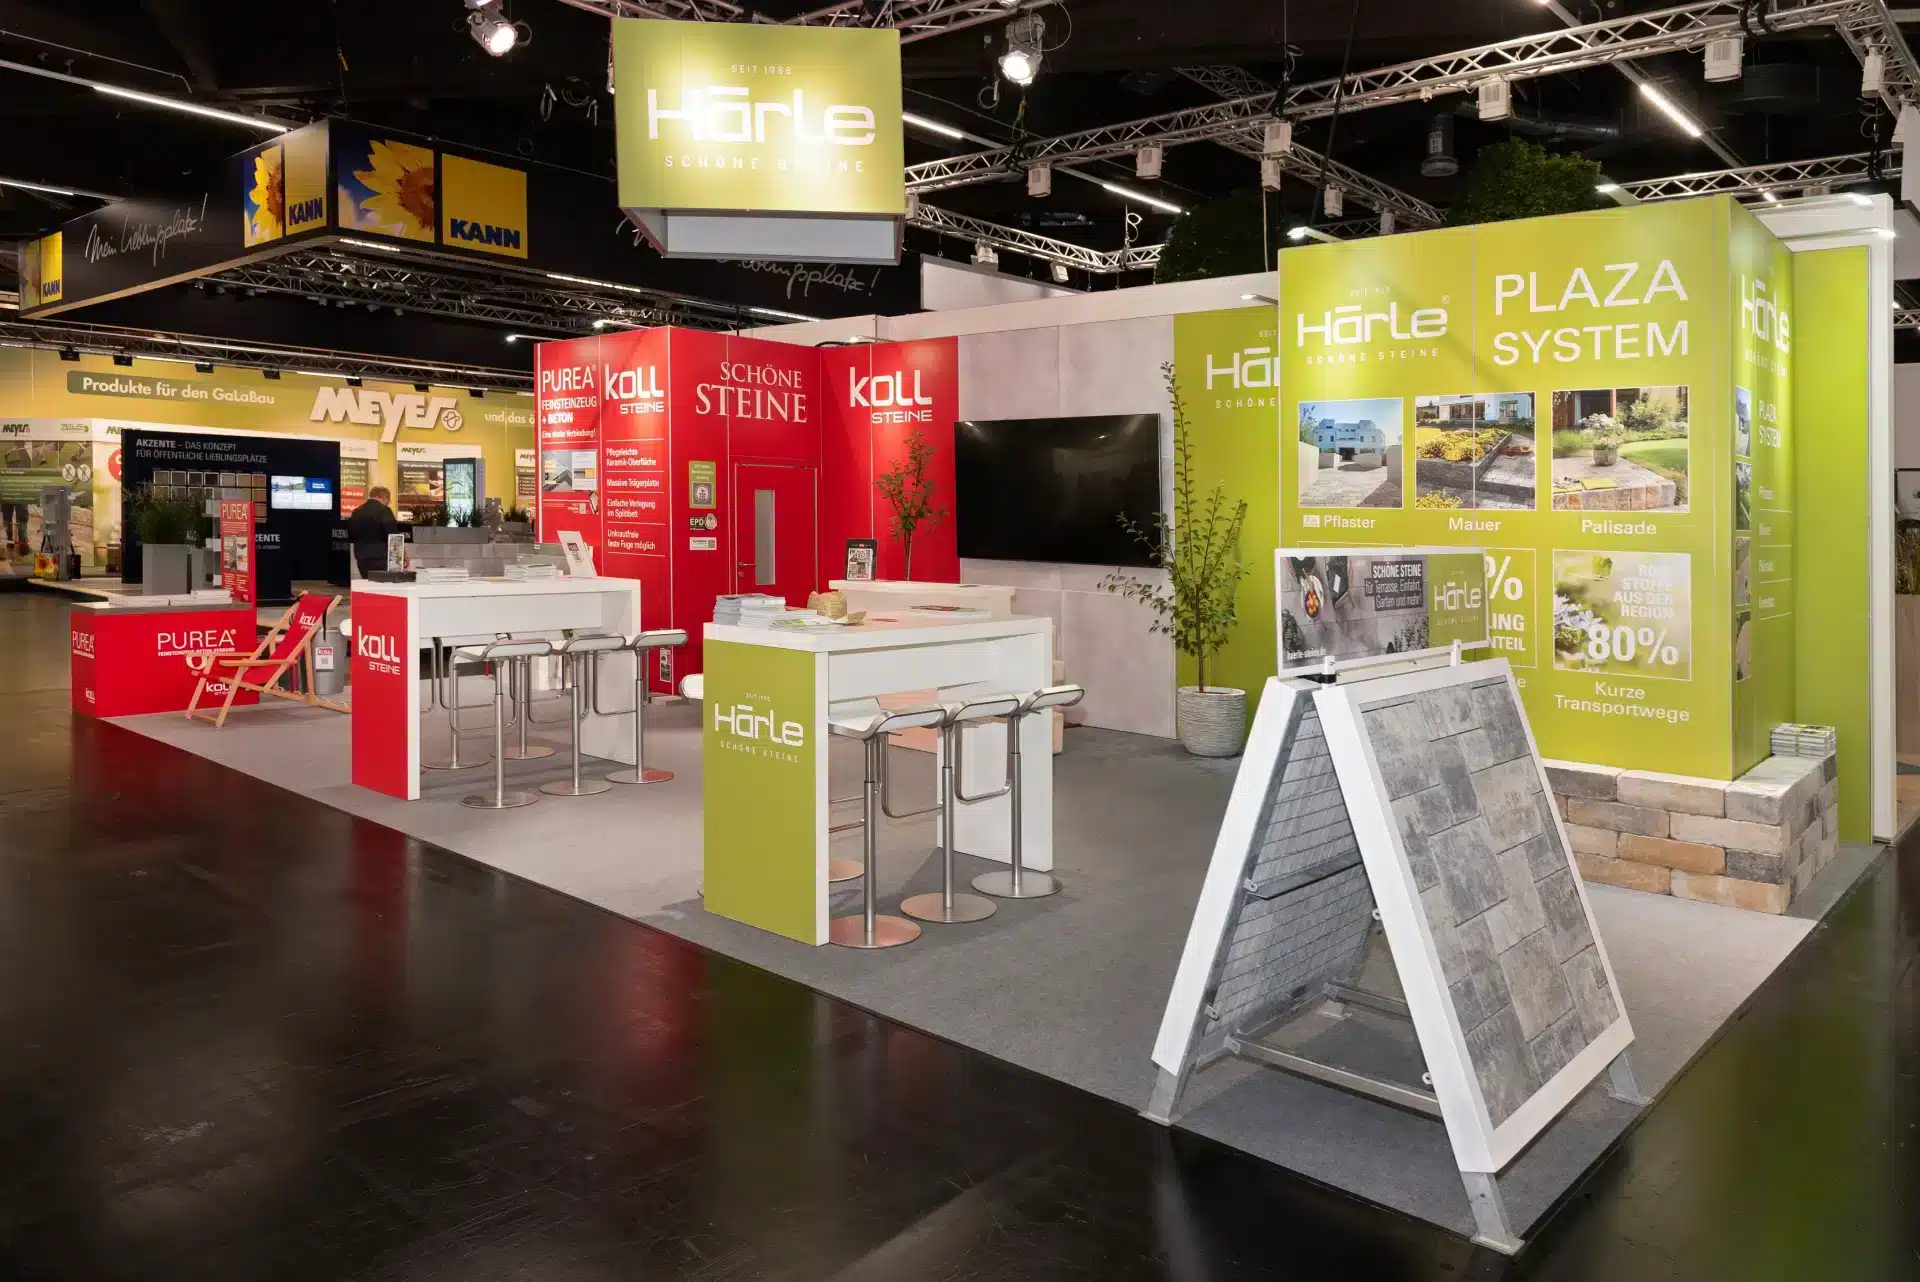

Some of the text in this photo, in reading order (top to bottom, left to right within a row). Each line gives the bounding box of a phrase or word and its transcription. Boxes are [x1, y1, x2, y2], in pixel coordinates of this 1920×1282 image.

[731, 64, 757, 74] SEIT
[289, 197, 323, 226] KANN
[450, 217, 520, 250] KANN
[42, 278, 61, 298] KANN
[1494, 259, 1689, 316] PLAZA
[1492, 320, 1689, 367] SYSTEM
[1379, 347, 1438, 361] STEINE
[720, 361, 802, 389] SCHÖNE
[82, 376, 275, 406] Produkte für den GaLaBau
[542, 395, 597, 411] FEINSTEINZEUG
[620, 401, 664, 415] STEINE
[695, 383, 808, 424] STEINE
[485, 411, 505, 422] und
[508, 412, 527, 424] das
[872, 409, 933, 424] STEINE
[136, 439, 176, 449] AKZENTE
[185, 441, 202, 450] DAS
[203, 442, 237, 452] KONZEPT
[136, 448, 268, 464] FÜR ÖFFENTLICHE LIEBLINGSPLÄTZE
[689, 517, 704, 527] EPD
[1323, 514, 1377, 529] Pflaster
[1448, 516, 1502, 531] Mauer
[1581, 519, 1657, 536] Palisade
[634, 541, 656, 552] möglich
[1372, 561, 1422, 579] SCHÖNE STEINE
[1612, 591, 1643, 605] AUS
[1621, 604, 1675, 619] REGION
[1587, 623, 1680, 667] 80%
[368, 660, 401, 676] STEINE
[1595, 681, 1645, 700] Kurze
[1553, 694, 1690, 724] Transportwege
[763, 748, 799, 764] STEINE
